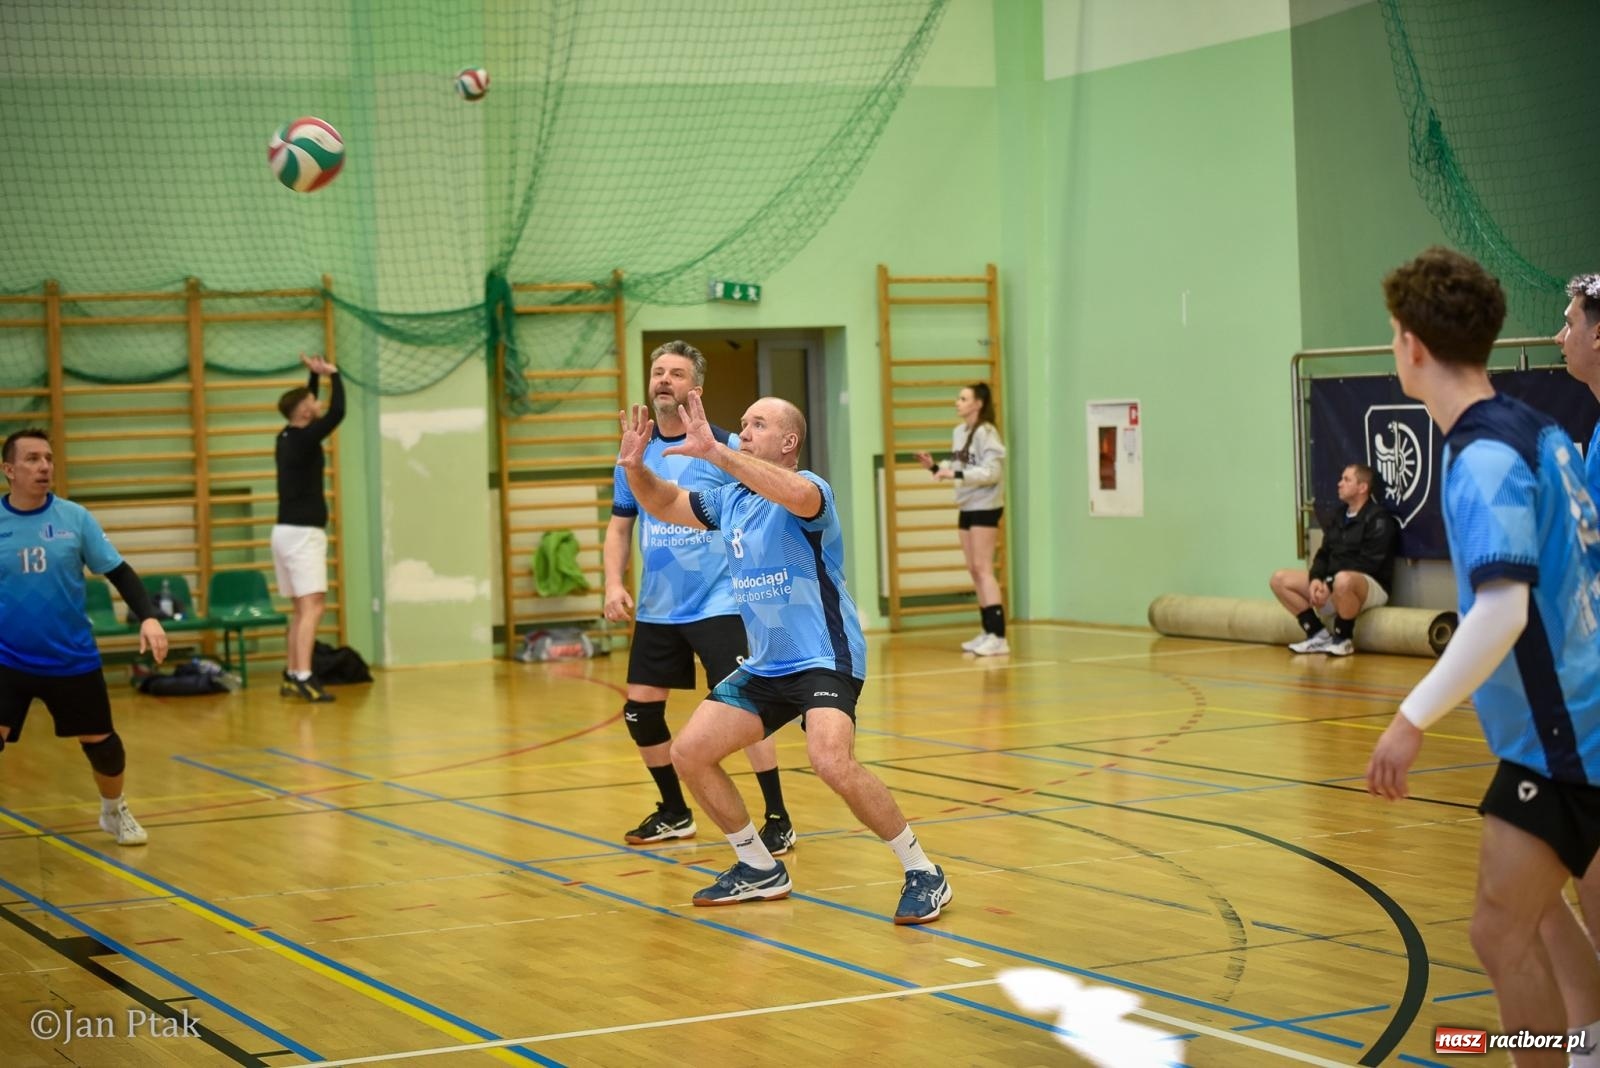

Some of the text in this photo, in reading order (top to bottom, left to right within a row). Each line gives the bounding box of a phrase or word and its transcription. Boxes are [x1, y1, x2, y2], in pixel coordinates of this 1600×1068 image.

[650, 524, 707, 536] Wodociąg
[650, 535, 713, 547] Raciborskie
[731, 528, 744, 559] 8
[17, 546, 47, 574] 13
